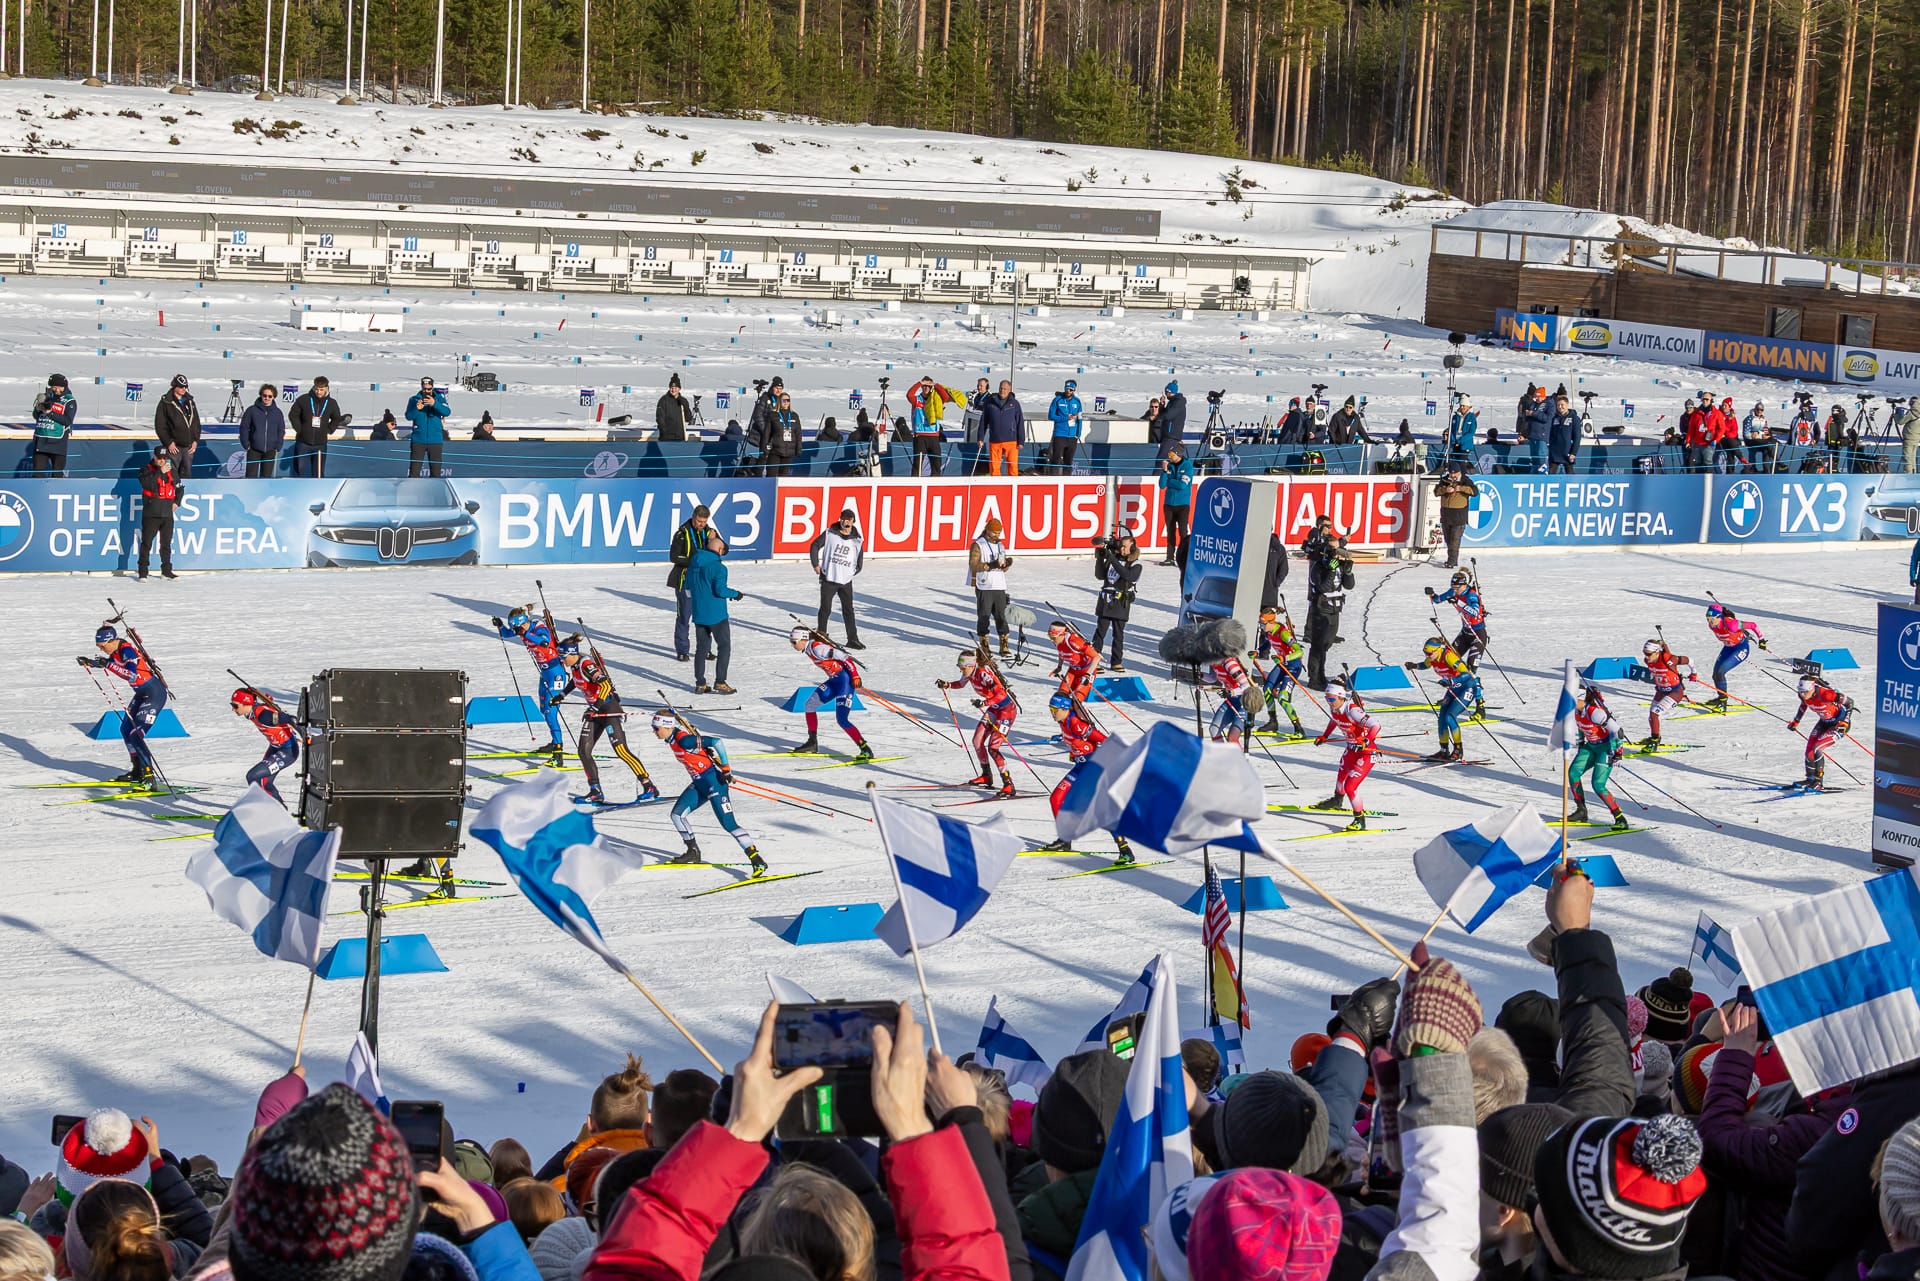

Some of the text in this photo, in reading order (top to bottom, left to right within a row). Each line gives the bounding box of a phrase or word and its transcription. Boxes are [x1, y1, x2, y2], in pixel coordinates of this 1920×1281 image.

[14, 176, 54, 187] BULGARIA
[105, 181, 140, 190] UKRAINE
[195, 185, 233, 195] SLOVENIA
[282, 189, 312, 197] POLAND
[367, 192, 422, 202] UNITED STATES
[449, 196, 498, 206] SWITZERLAND
[530, 200, 564, 209] SLOVAKIA
[608, 204, 637, 212] AUSTRIA
[684, 207, 712, 215] CZECHIA
[53, 224, 66, 237] 15
[144, 227, 158, 241] 14
[234, 230, 246, 244] 13
[321, 234, 333, 247] 12
[405, 237, 416, 250] 11
[487, 240, 499, 253] 10
[1618, 331, 1696, 354] LAVITA.COM
[1707, 338, 1827, 373] HÖRMANN
[1095, 402, 1105, 412] 14
[1426, 406, 1436, 415] 11
[1626, 409, 1633, 418] 9
[1512, 482, 1630, 508] THE FIRST
[48, 494, 223, 522] THE FST
[1779, 482, 1848, 533] iX3
[498, 493, 655, 548] BMW
[1511, 512, 1674, 538] OF A NEW ERA.
[49, 528, 95, 557] OF
[101, 528, 124, 556] A
[215, 526, 288, 555] ERA.
[1195, 534, 1238, 554] THE NEW
[834, 544, 850, 555] HB
[1194, 548, 1234, 568] BMW iX3
[1884, 679, 1914, 700] THE
[1882, 697, 1919, 719] BMW
